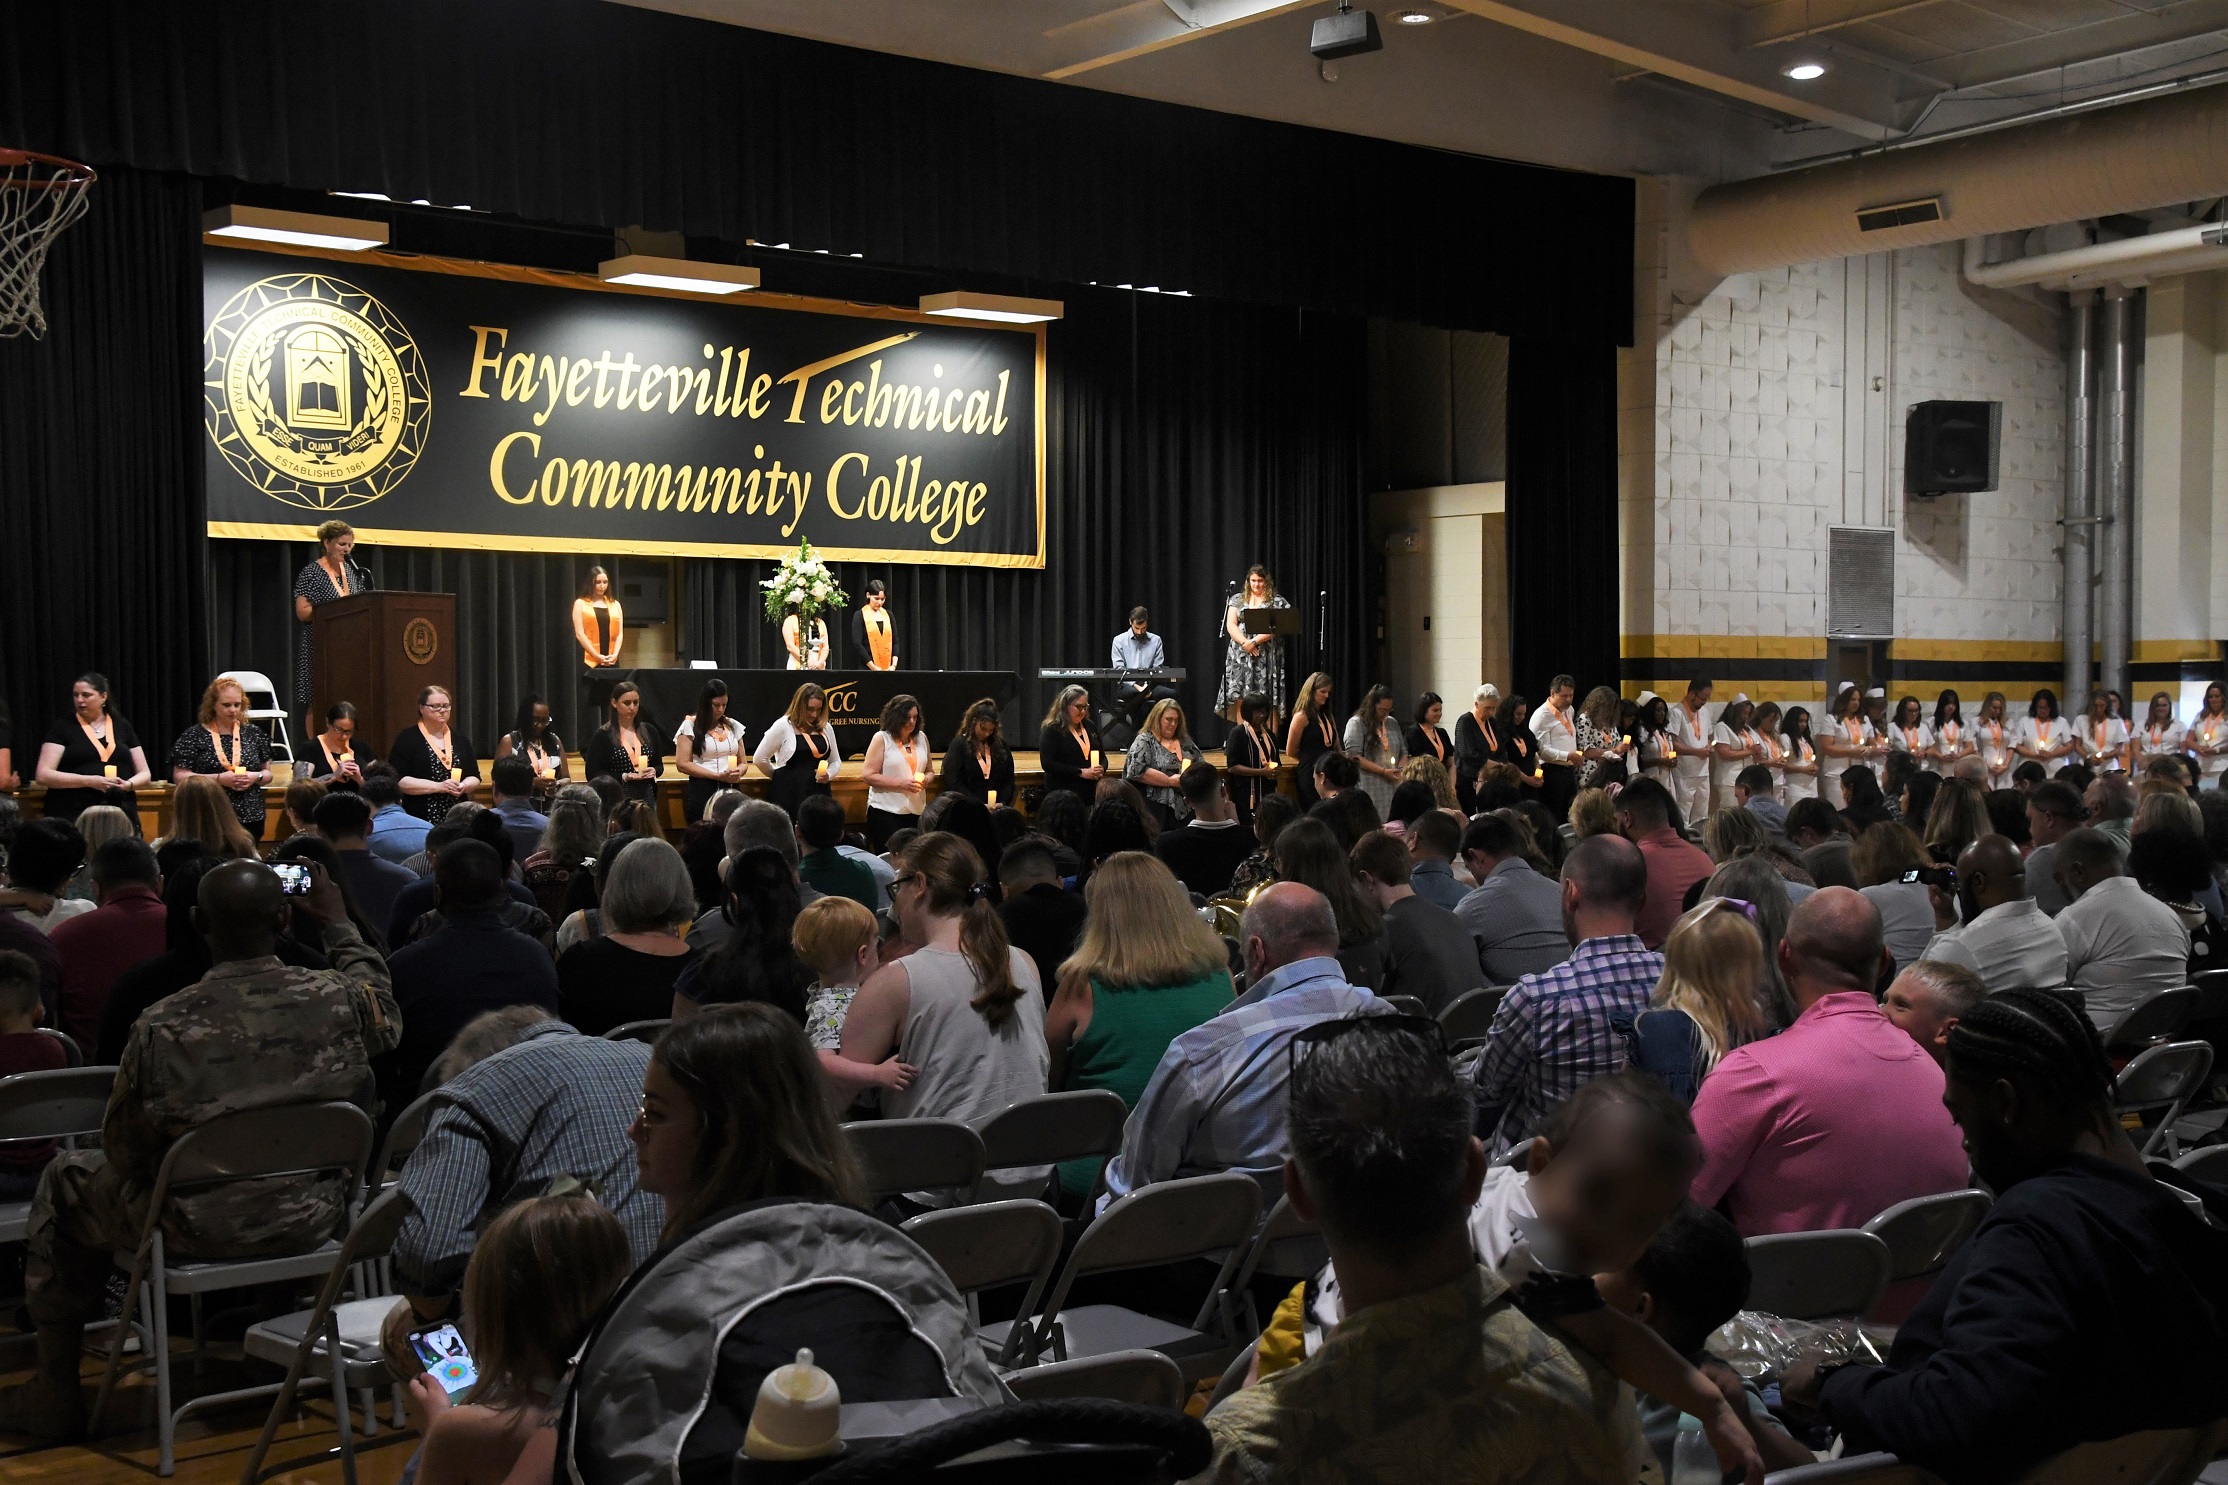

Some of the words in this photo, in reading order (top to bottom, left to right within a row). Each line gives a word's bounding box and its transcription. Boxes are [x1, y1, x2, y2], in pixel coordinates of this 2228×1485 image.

[232, 330, 260, 412] FAYETTEVILLE
[262, 307, 326, 328] TECHNICAL
[331, 311, 391, 362] COMMUNITY
[386, 367, 402, 424] COLLEGE
[458, 325, 772, 426] Fayetteville
[776, 331, 1010, 437] Technical
[271, 428, 294, 447] ESSE
[307, 442, 333, 452] QUAM
[347, 432, 371, 450] VIDERI
[274, 455, 344, 478] ESTABLISHED
[346, 460, 367, 475] 1961
[489, 431, 812, 538] Community
[826, 452, 988, 545] College
[829, 718, 848, 726] GREE
[848, 717, 880, 725] NURSING
